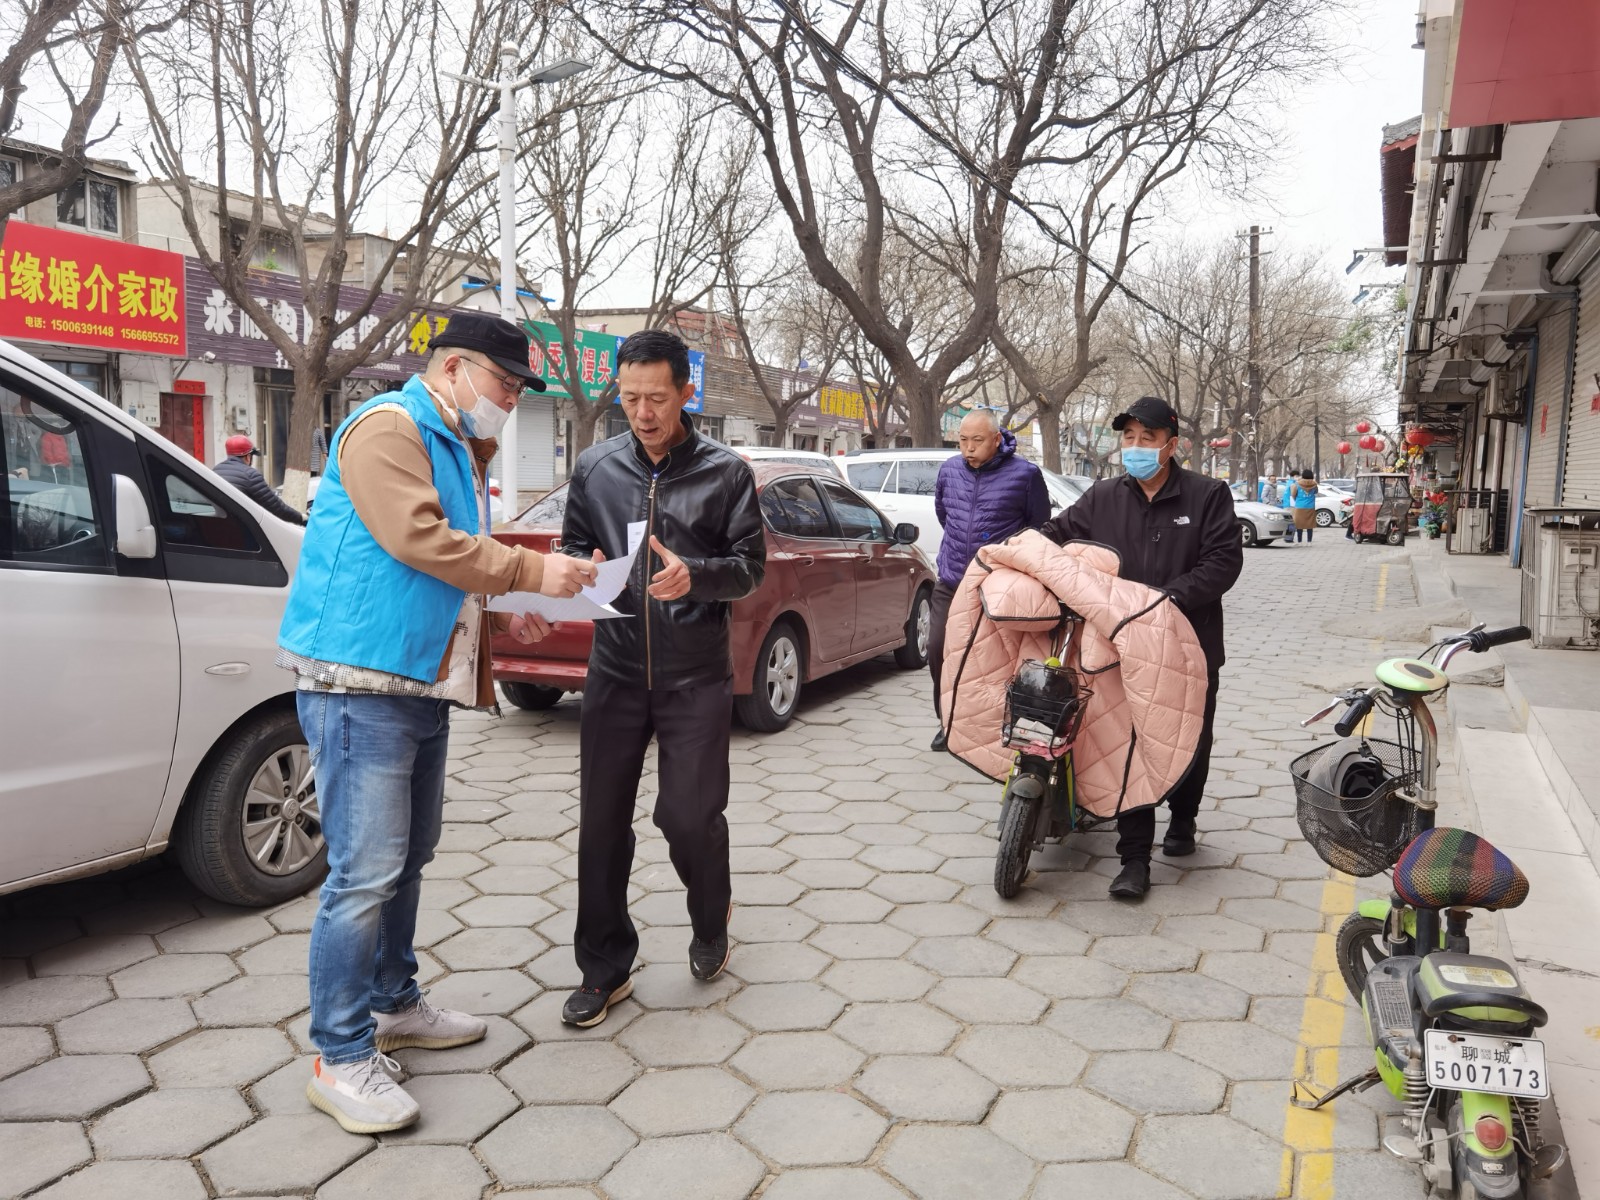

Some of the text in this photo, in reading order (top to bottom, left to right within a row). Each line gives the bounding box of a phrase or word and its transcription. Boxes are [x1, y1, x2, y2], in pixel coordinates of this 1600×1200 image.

[51, 319, 114, 337] 15006391148
[121, 328, 179, 345] 15666955572
[528, 339, 612, 384] 奶香馒头
[1435, 1061, 1540, 1090] 5007173
